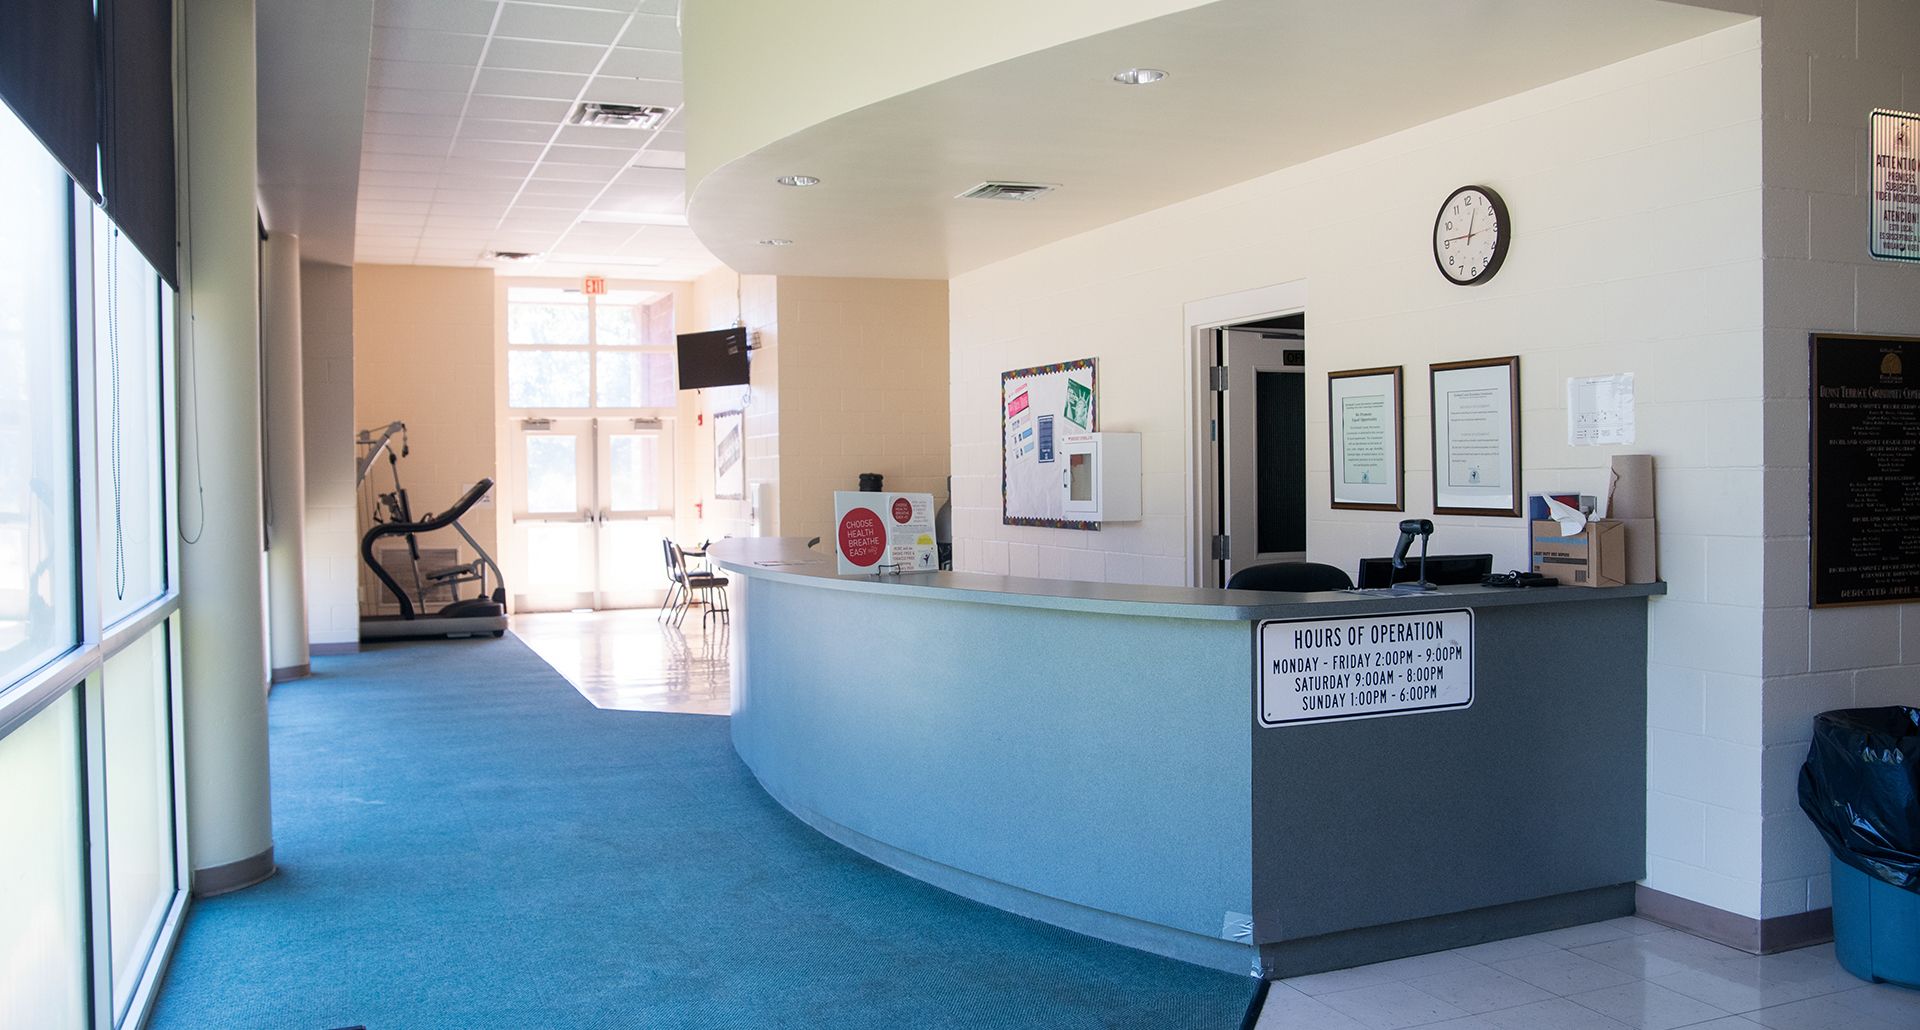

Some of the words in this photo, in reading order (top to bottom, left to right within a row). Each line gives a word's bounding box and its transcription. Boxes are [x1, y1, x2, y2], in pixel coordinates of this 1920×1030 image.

[1888, 170, 1916, 183] PREMISES
[1886, 182, 1908, 193] SUBJECT
[1464, 196, 1472, 206] 12
[1479, 196, 1482, 205] 1
[1876, 190, 1892, 202] VIDEO
[1454, 205, 1460, 215] 11
[1488, 205, 1494, 216] 2
[1445, 221, 1453, 231] 10
[1492, 222, 1498, 232] 3
[1444, 240, 1450, 249] 9
[1491, 241, 1496, 250] 4
[1449, 256, 1454, 266] 8
[1483, 257, 1489, 267] 5
[1459, 265, 1464, 275] 7
[1471, 266, 1477, 276] 6
[586, 280, 604, 294] EXIT
[846, 519, 873, 529] CHOOSE
[848, 528, 874, 538] HEALTH
[848, 536, 880, 548] BREATHE
[850, 548, 867, 556] EASY
[1295, 628, 1342, 650] HOURS
[1348, 626, 1364, 646] OF
[1371, 621, 1443, 644] OPERATION
[1273, 657, 1319, 675] MONDAY
[1333, 653, 1371, 670] FRIDAY
[1375, 650, 1413, 667] 2:00PM
[1426, 646, 1462, 663] 9:00PM
[1295, 674, 1350, 692] SATURDAY
[1355, 670, 1394, 687] 9:00AM
[1407, 666, 1444, 683] 8:00PM
[1302, 693, 1346, 711] SUNDAY
[1351, 689, 1387, 706] 1:00PM
[1400, 685, 1437, 702] 6:00PM
